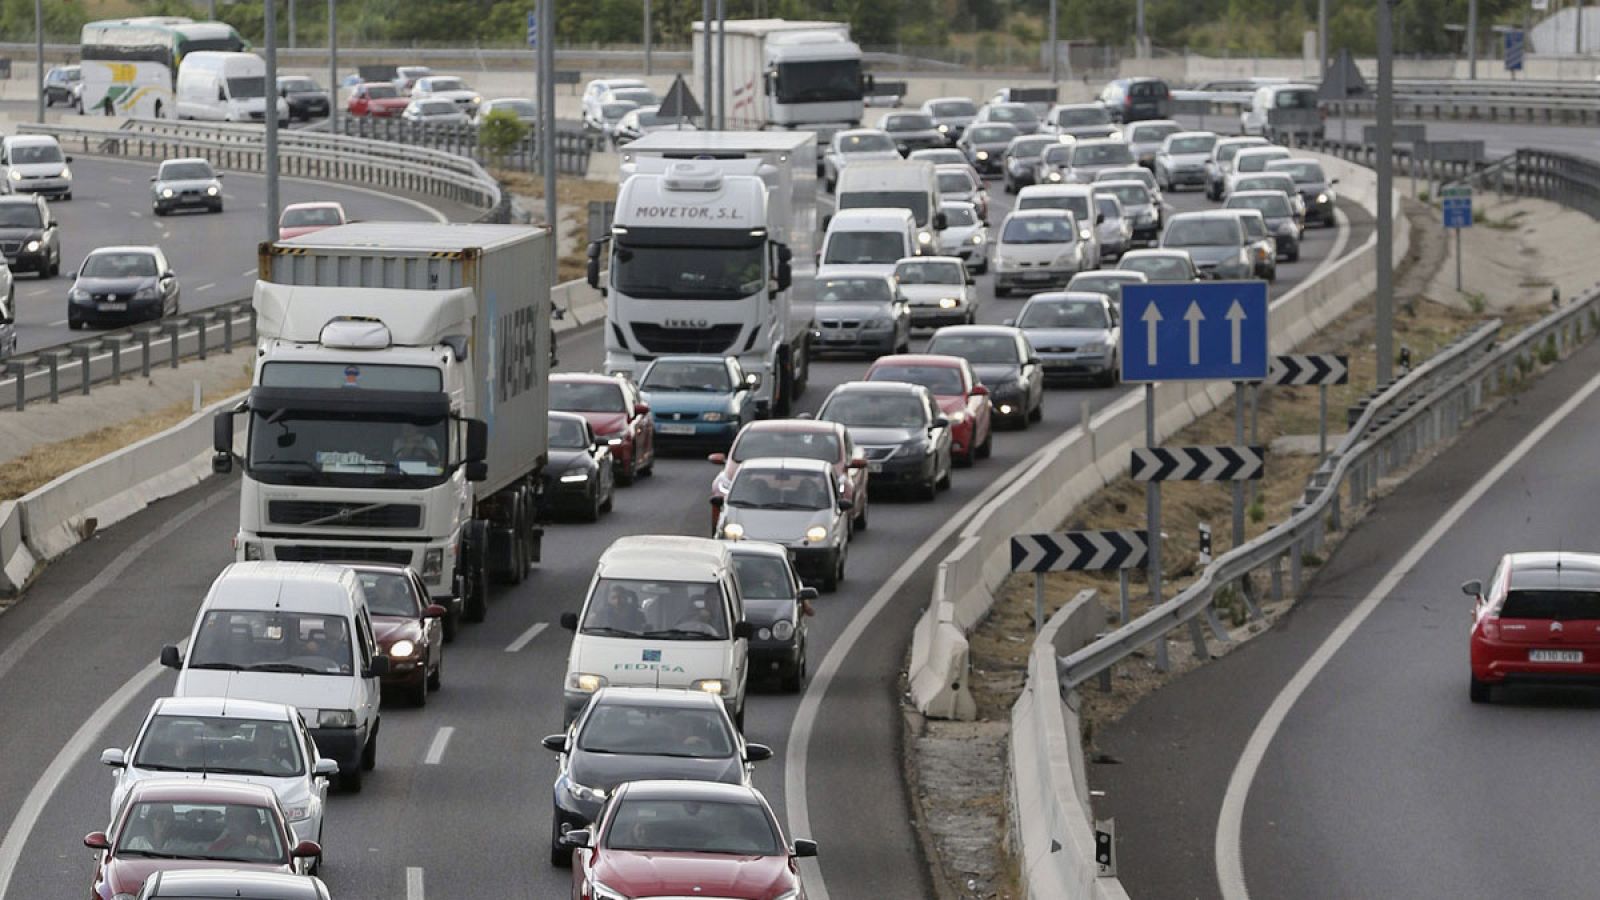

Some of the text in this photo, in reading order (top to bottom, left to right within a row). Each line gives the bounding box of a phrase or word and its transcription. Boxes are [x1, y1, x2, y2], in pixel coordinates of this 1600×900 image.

[636, 206, 744, 220] MOVETOR, S.L.
[614, 663, 685, 673] FEDESA
